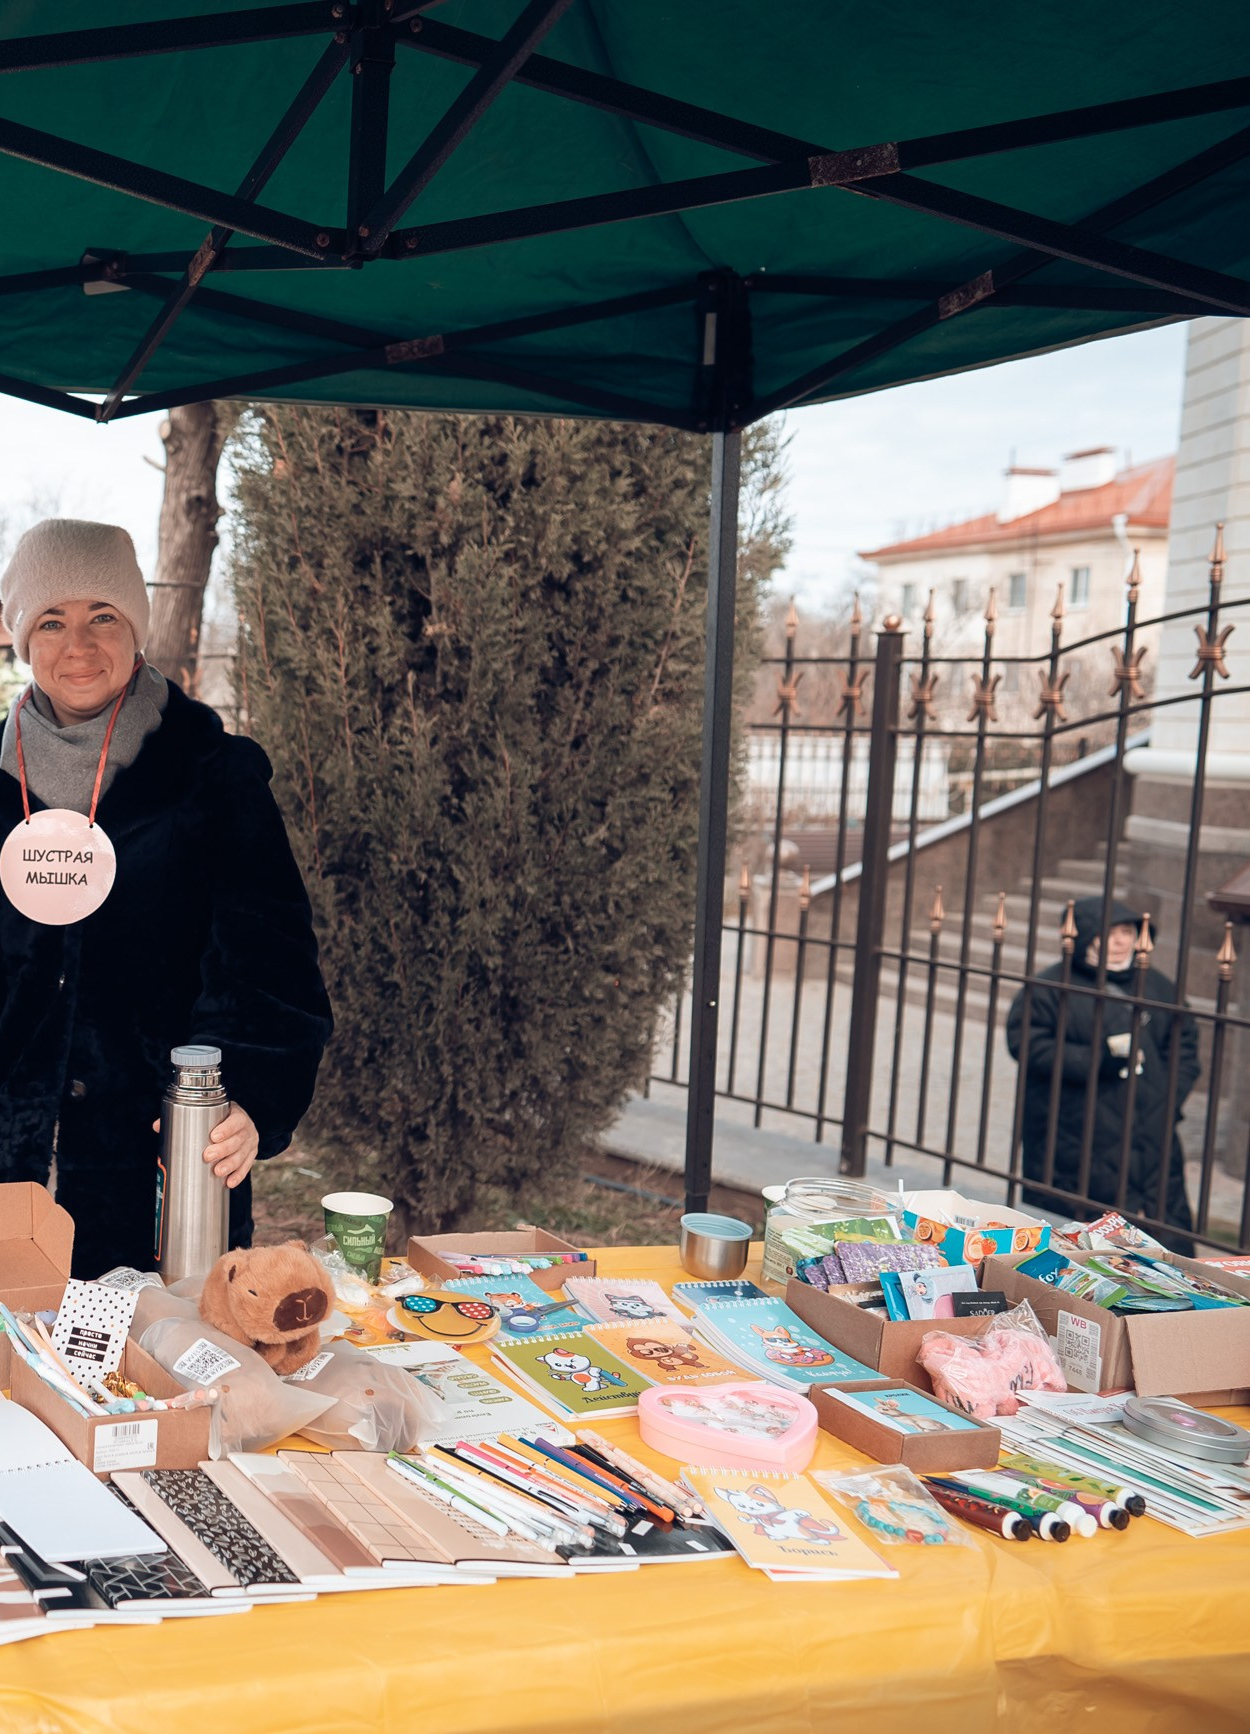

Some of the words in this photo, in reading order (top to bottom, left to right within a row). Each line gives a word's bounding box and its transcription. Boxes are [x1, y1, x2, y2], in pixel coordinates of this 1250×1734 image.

[23, 849, 93, 863] ШУСТРАЯ
[25, 871, 88, 885] МЫШКА
[342, 1234, 376, 1247] СИЛЬНЫЙ
[1070, 1316, 1087, 1330] WB
[79, 1329, 103, 1339] просто
[77, 1340, 98, 1349] начни
[73, 1350, 97, 1360] сейчас
